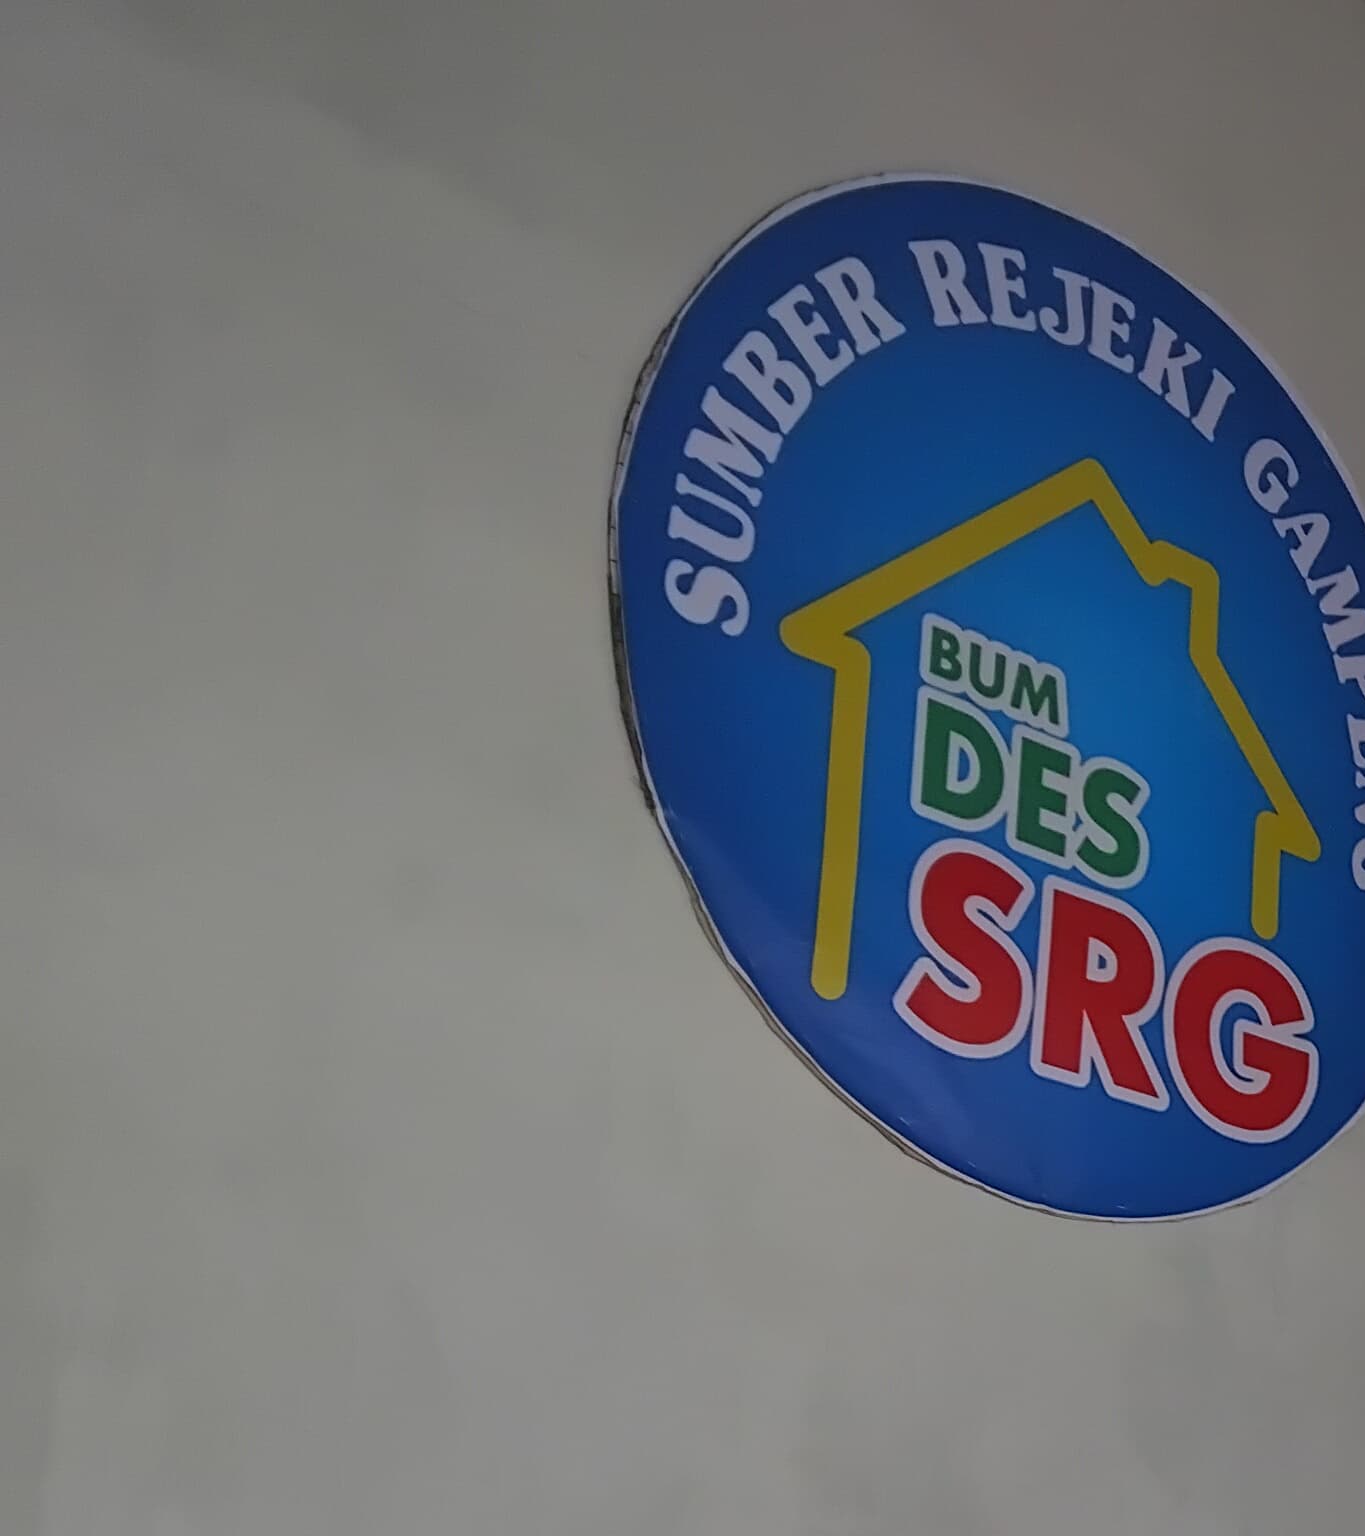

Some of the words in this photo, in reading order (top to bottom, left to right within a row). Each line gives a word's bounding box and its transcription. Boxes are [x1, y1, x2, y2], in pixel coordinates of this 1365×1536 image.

[664, 256, 906, 637] SUMBER
[908, 238, 1236, 443] REJEKI
[915, 694, 1144, 884] DES
[925, 616, 1063, 728] BUM
[898, 842, 1313, 1140] SRG
